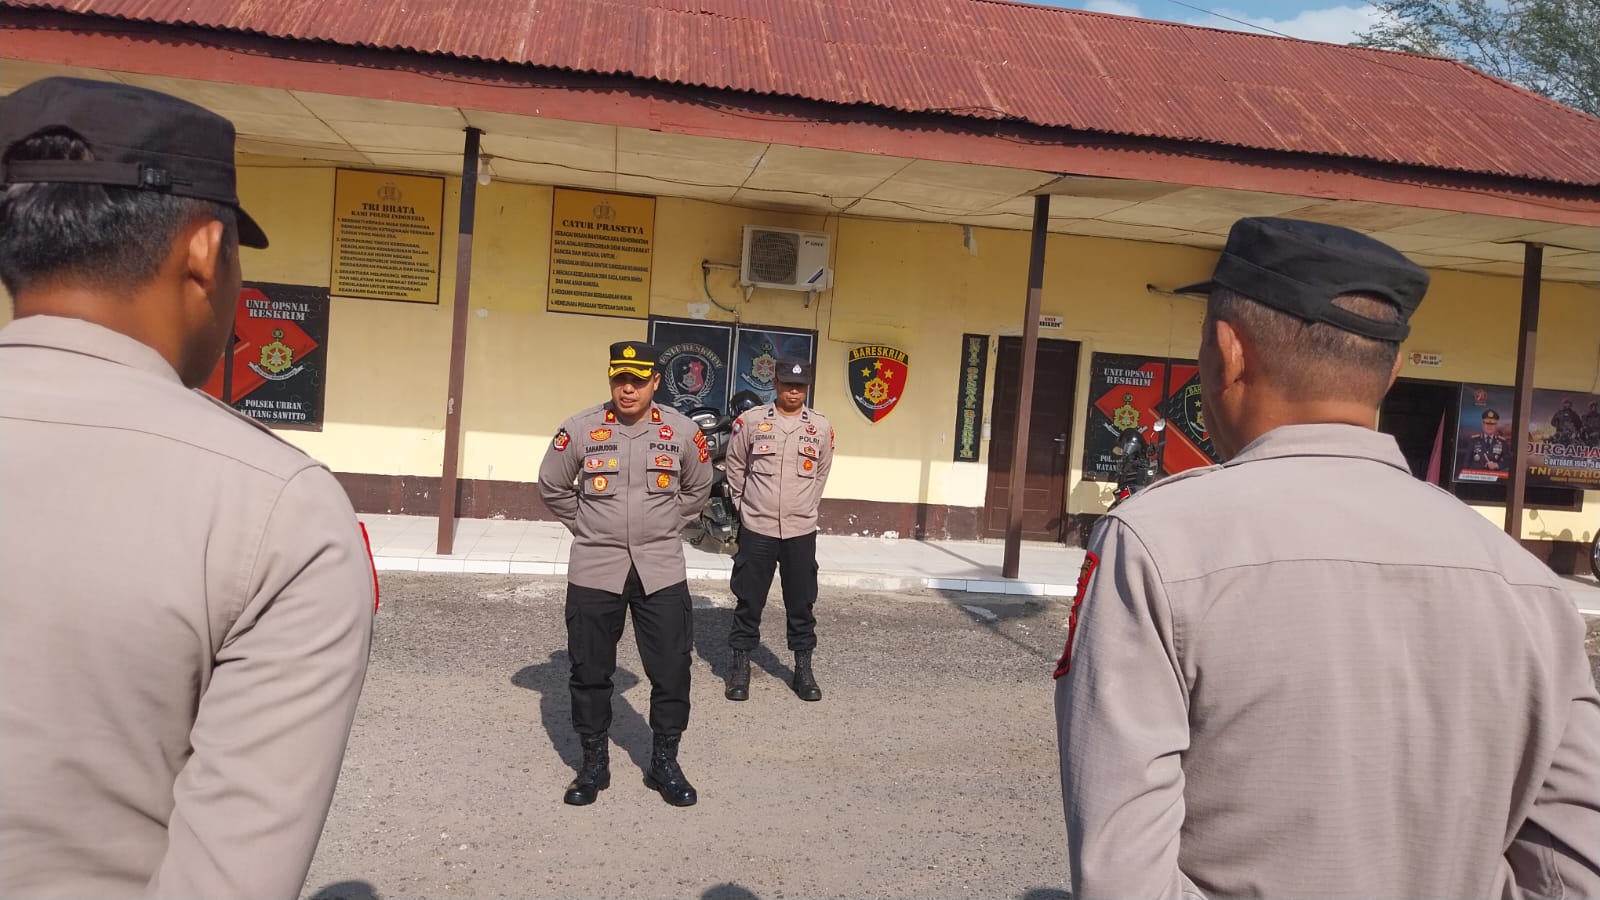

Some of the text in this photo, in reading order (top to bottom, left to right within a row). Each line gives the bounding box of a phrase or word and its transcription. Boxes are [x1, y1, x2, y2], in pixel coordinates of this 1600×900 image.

[362, 203, 415, 214] TRI BRATA
[562, 220, 644, 234] CATUR PRASETYA
[246, 300, 310, 312] UNIT OPSNAL
[249, 309, 305, 320] RESKRIM
[853, 346, 905, 361] BARESKRIM
[1104, 368, 1154, 379] UNIT OPSNAL
[1106, 377, 1151, 386] RESKRIM
[246, 400, 302, 410] POLSEK URBAN
[272, 411, 306, 420] SAWITTO
[800, 436, 820, 444] POLRI
[649, 442, 680, 453] POLRI
[1530, 466, 1552, 476] TNI
